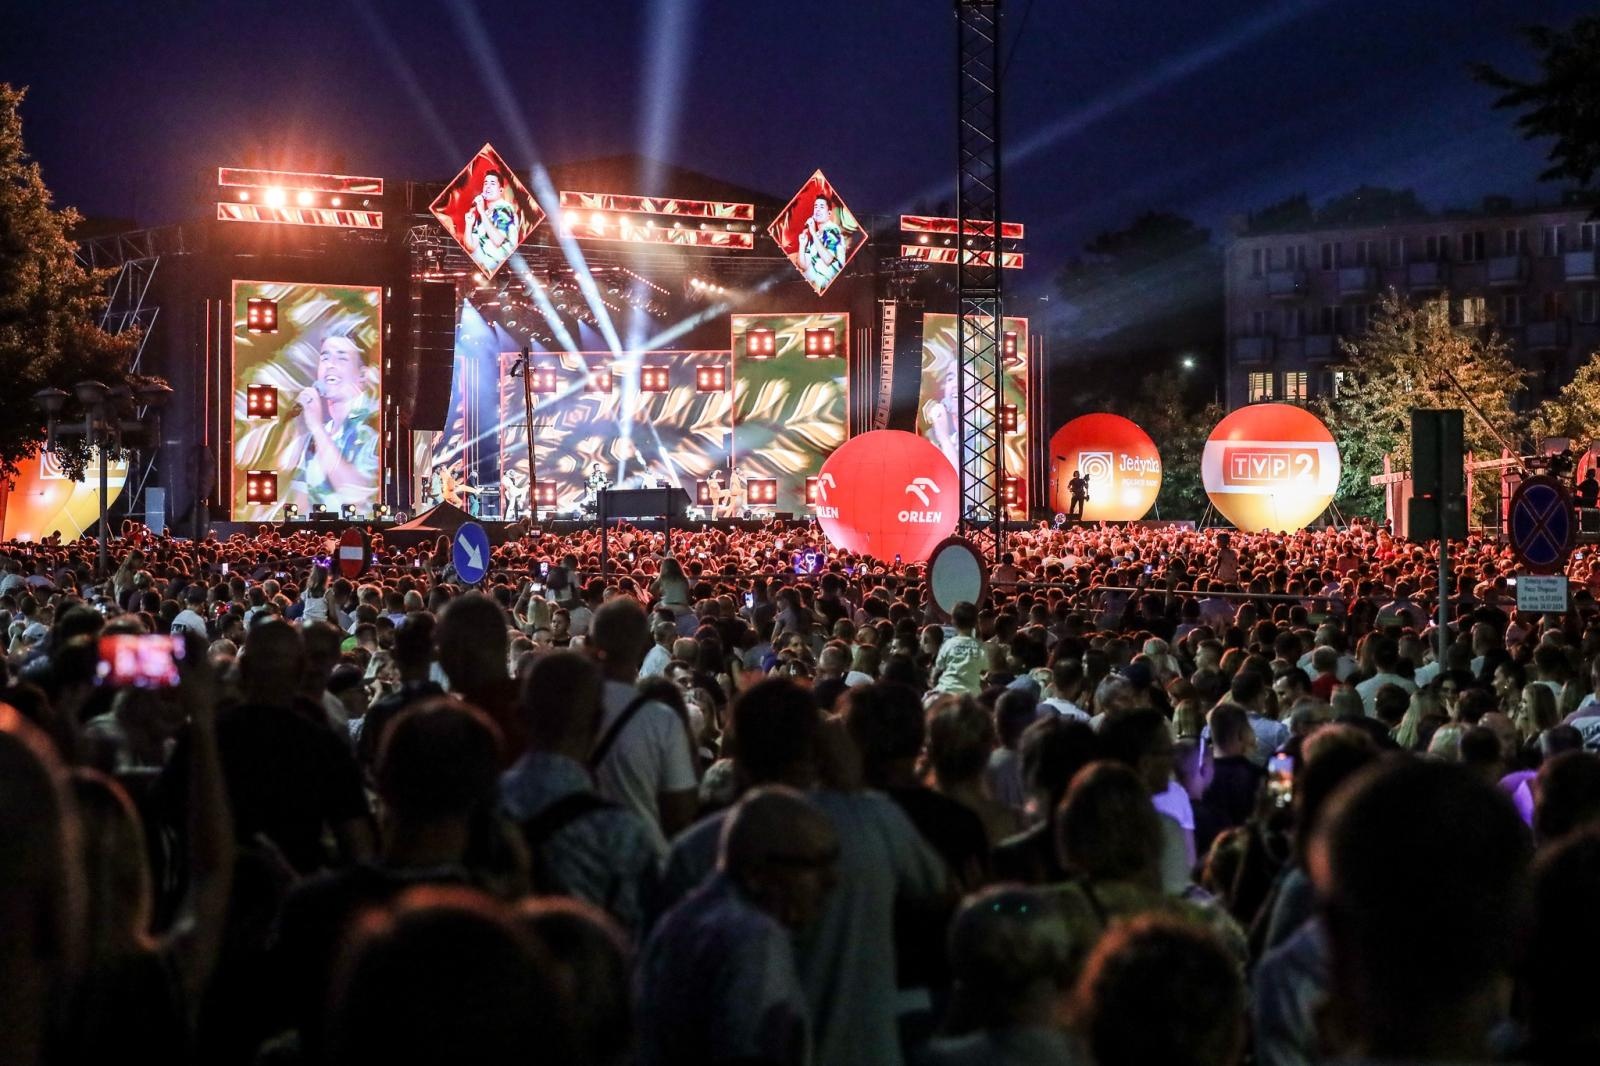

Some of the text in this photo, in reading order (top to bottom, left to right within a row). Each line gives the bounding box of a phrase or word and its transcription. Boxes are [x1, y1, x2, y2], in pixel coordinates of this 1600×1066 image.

[1119, 453, 1160, 477] Jedynka
[1234, 453, 1314, 480] TVP 2
[898, 510, 942, 523] ORLEN
